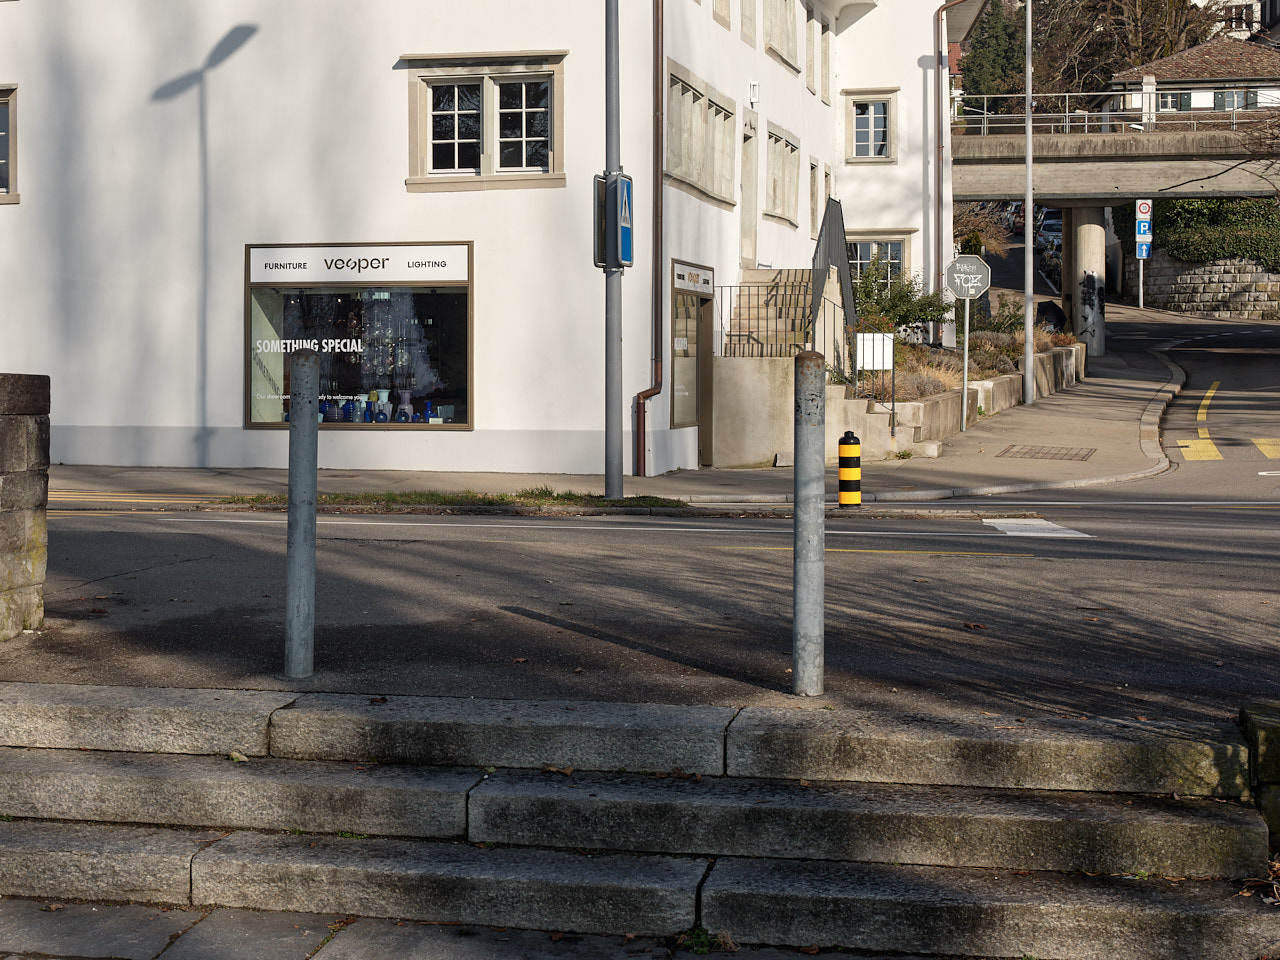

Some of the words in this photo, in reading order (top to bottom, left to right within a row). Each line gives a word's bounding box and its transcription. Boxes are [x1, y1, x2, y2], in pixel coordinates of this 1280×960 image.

[1140, 222, 1149, 234] P
[264, 262, 307, 270] FURNITURE
[324, 257, 389, 273] vesper
[407, 260, 447, 268] LIGHTING
[256, 339, 319, 353] SOMETHING
[321, 338, 364, 353] SPECIAL
